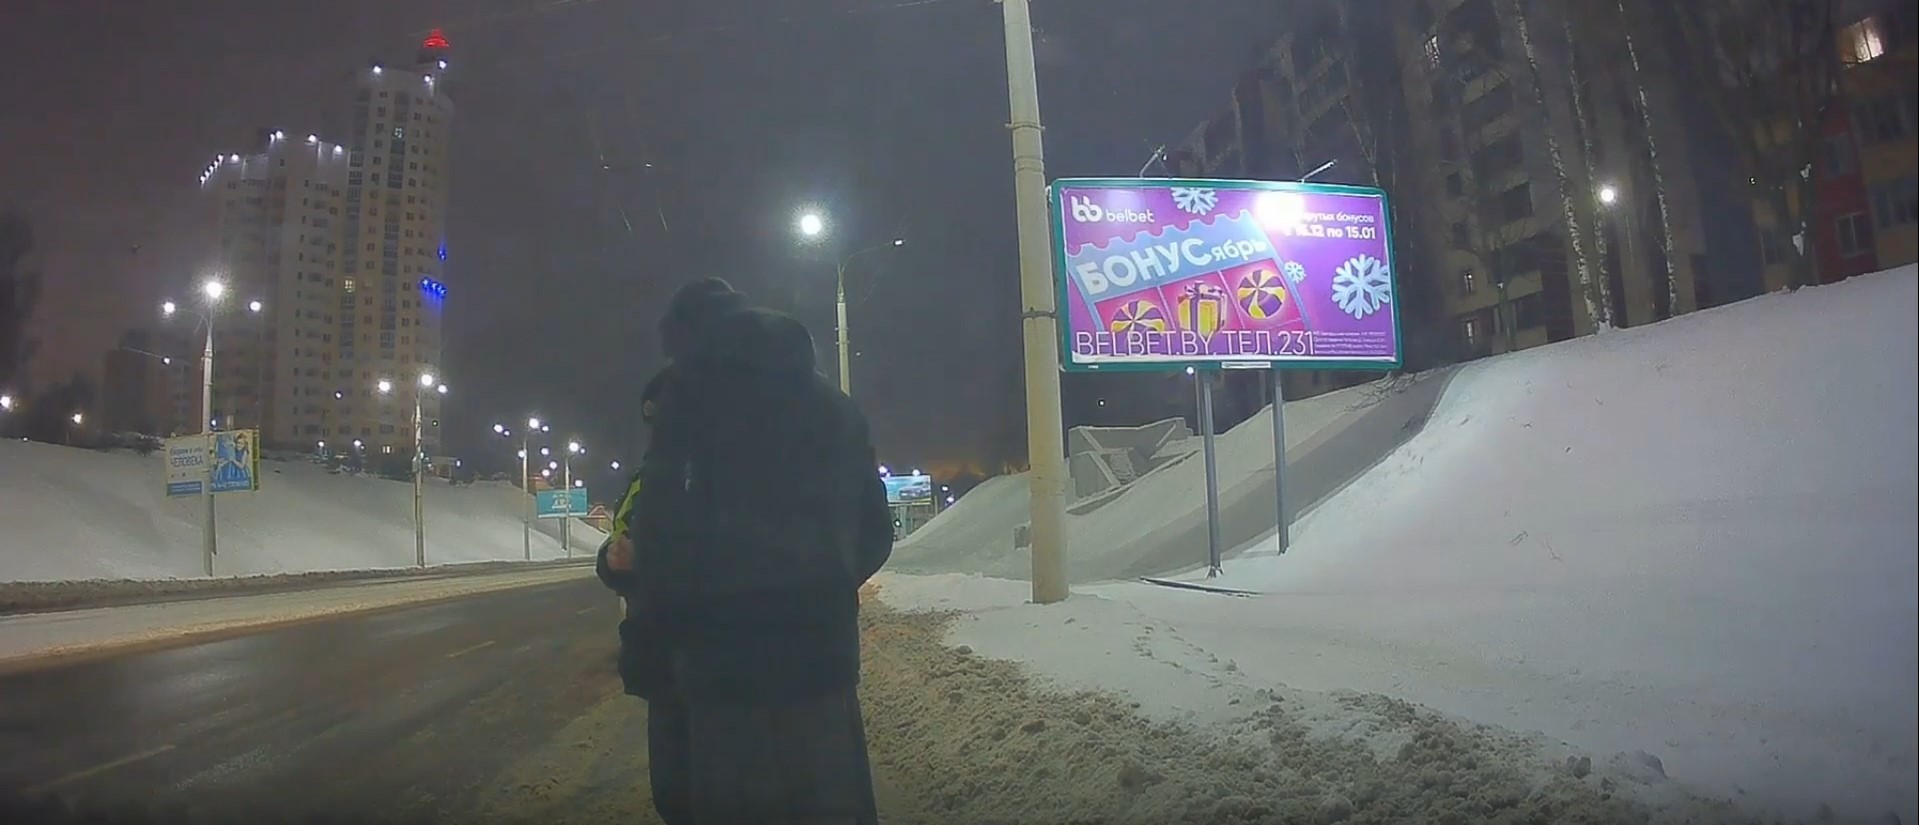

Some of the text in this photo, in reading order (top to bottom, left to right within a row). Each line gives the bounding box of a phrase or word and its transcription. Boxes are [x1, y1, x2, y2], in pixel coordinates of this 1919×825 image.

[1105, 208, 1155, 223] belbet
[1336, 211, 1375, 225] бонусов
[1327, 226, 1344, 239] по
[1345, 226, 1376, 240] 15.01
[1222, 330, 1315, 355] ТЕЛ.231
